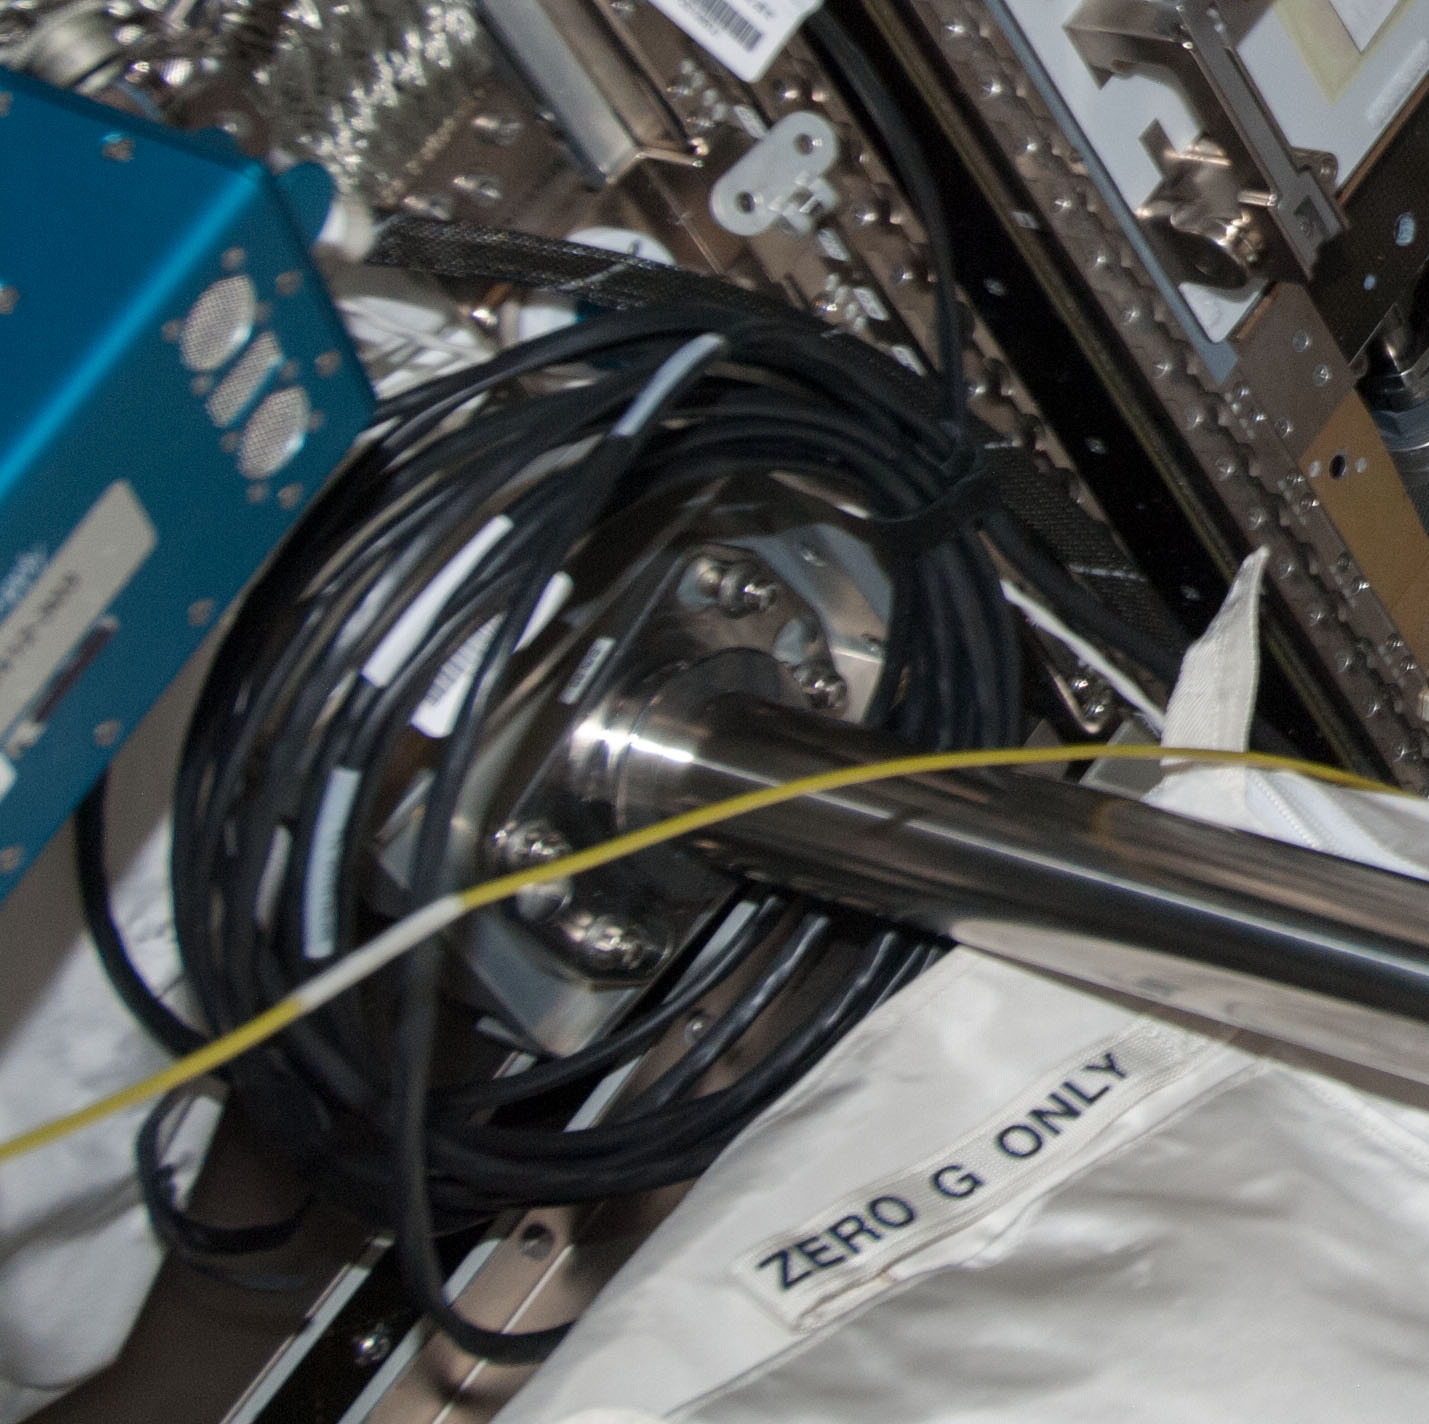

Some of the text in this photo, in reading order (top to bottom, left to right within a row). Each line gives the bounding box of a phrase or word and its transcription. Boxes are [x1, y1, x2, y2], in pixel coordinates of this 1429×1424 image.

[755, 1049, 1142, 1299] ZERO G ONLY
